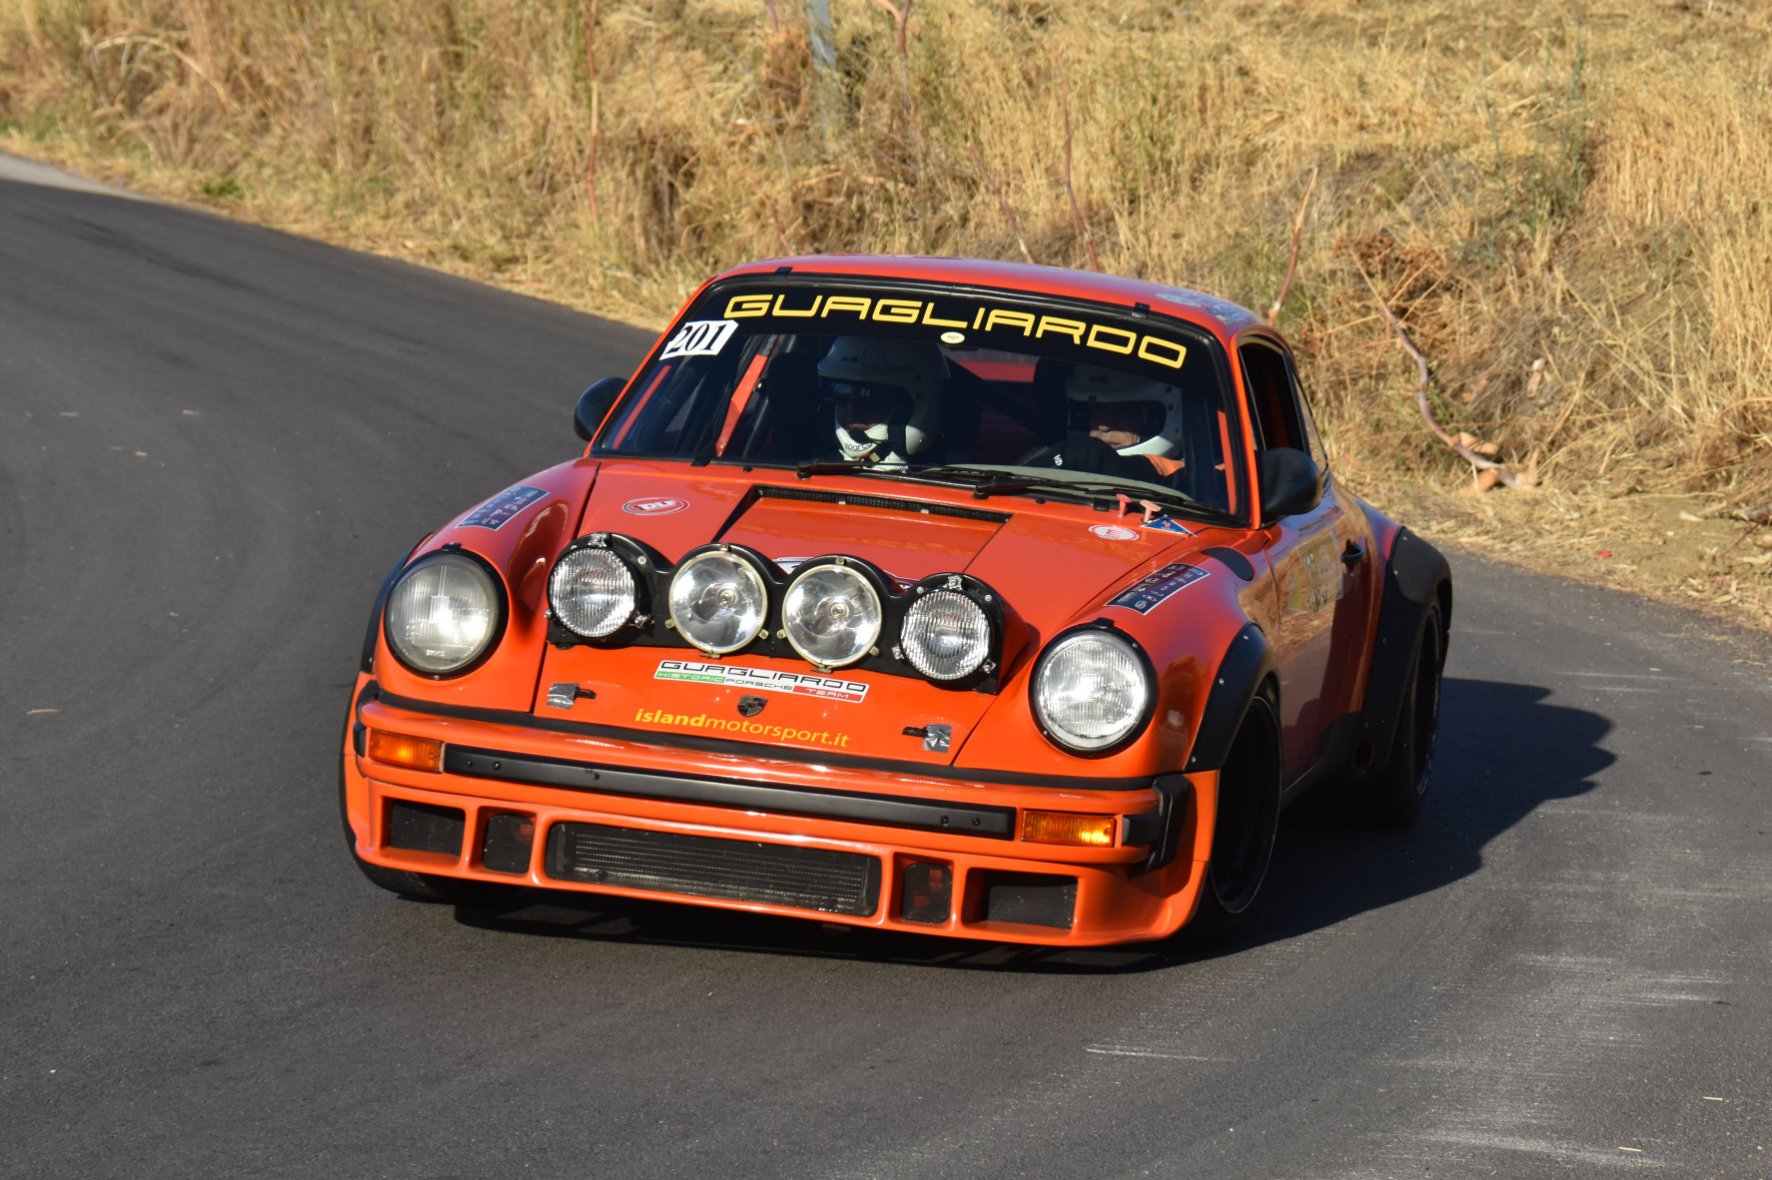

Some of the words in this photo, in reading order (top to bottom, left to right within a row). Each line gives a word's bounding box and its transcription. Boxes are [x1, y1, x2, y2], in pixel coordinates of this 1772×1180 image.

[665, 322, 727, 355] 201
[723, 294, 1187, 369] GUAGLIARDO
[657, 672, 725, 684] HISTORIC
[725, 678, 793, 690] PORSCHE
[806, 687, 850, 700] TEAM
[660, 661, 867, 691] GUAGLIARDO
[634, 708, 850, 747] islandmotorsport.it
